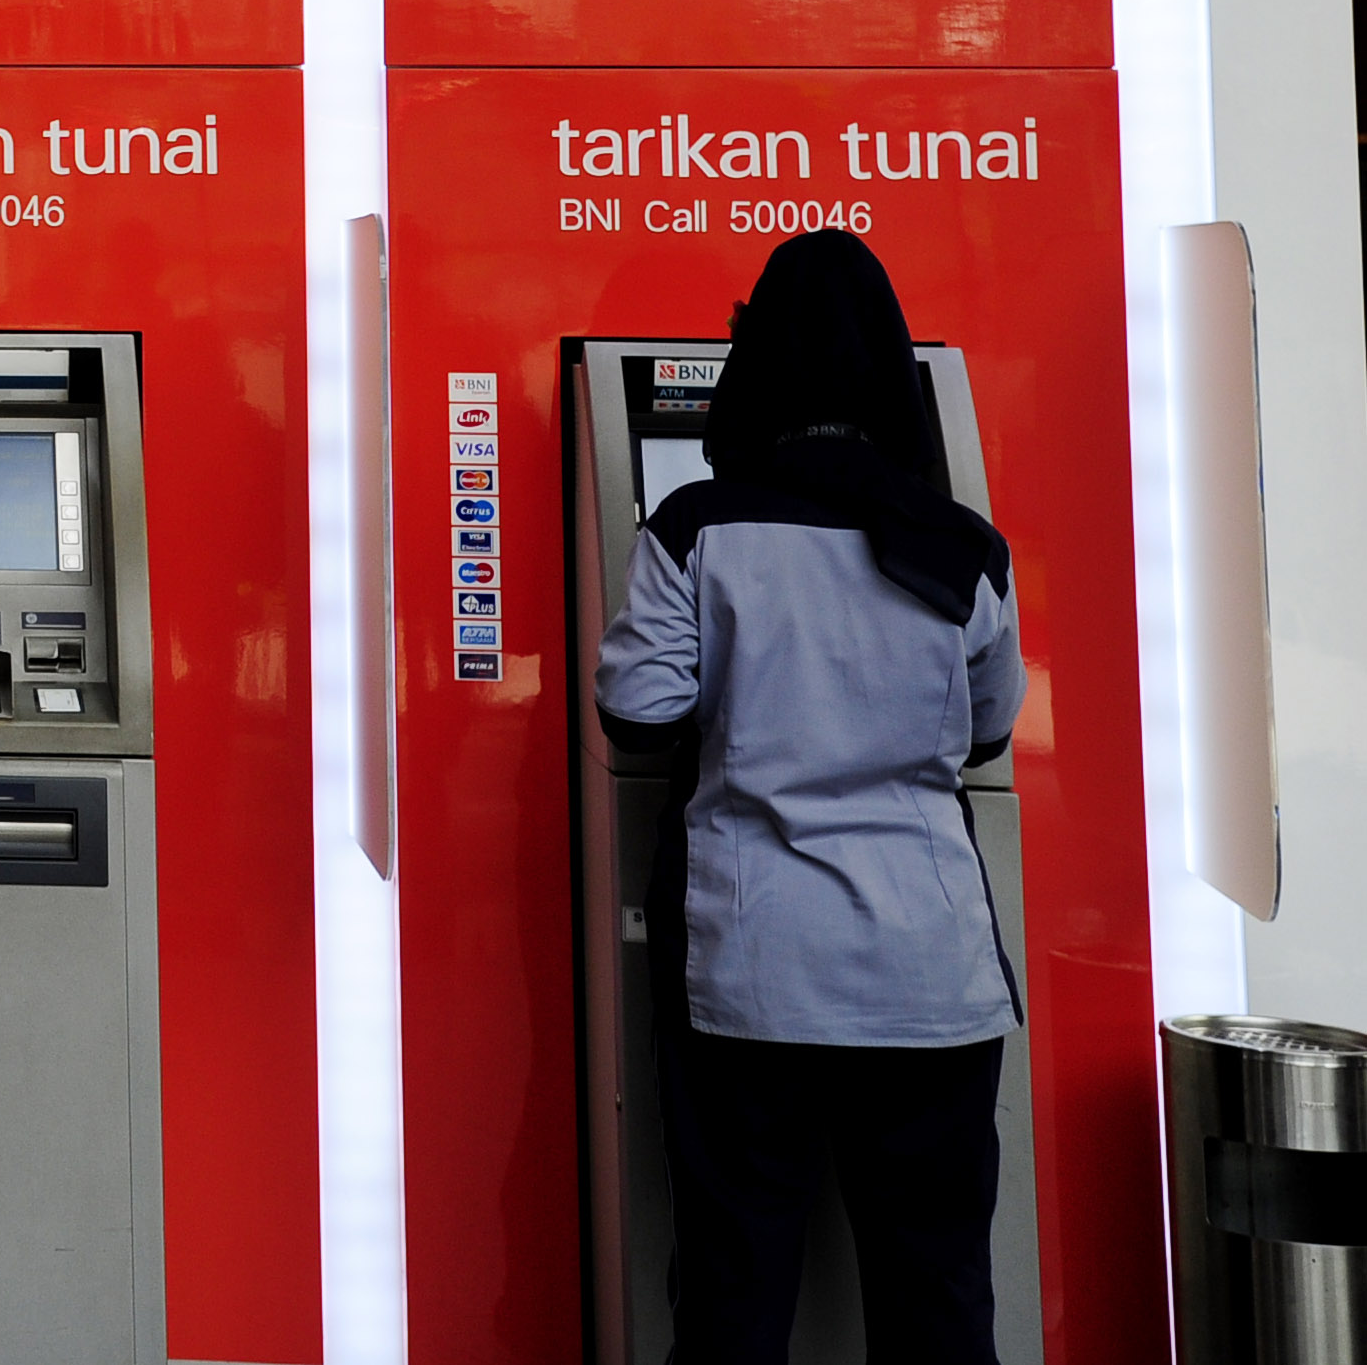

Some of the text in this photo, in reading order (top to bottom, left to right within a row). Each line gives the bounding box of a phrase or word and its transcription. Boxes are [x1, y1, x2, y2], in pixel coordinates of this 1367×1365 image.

[43, 115, 217, 175] tunai
[552, 114, 1038, 180] tarikan tunai
[560, 199, 873, 233] BNI Call 500046
[679, 365, 713, 380] BNI
[468, 379, 490, 390] BNI
[660, 389, 684, 397] ATM
[459, 412, 487, 425] Link
[455, 442, 495, 456] VISA
[461, 507, 491, 516] Cirrus
